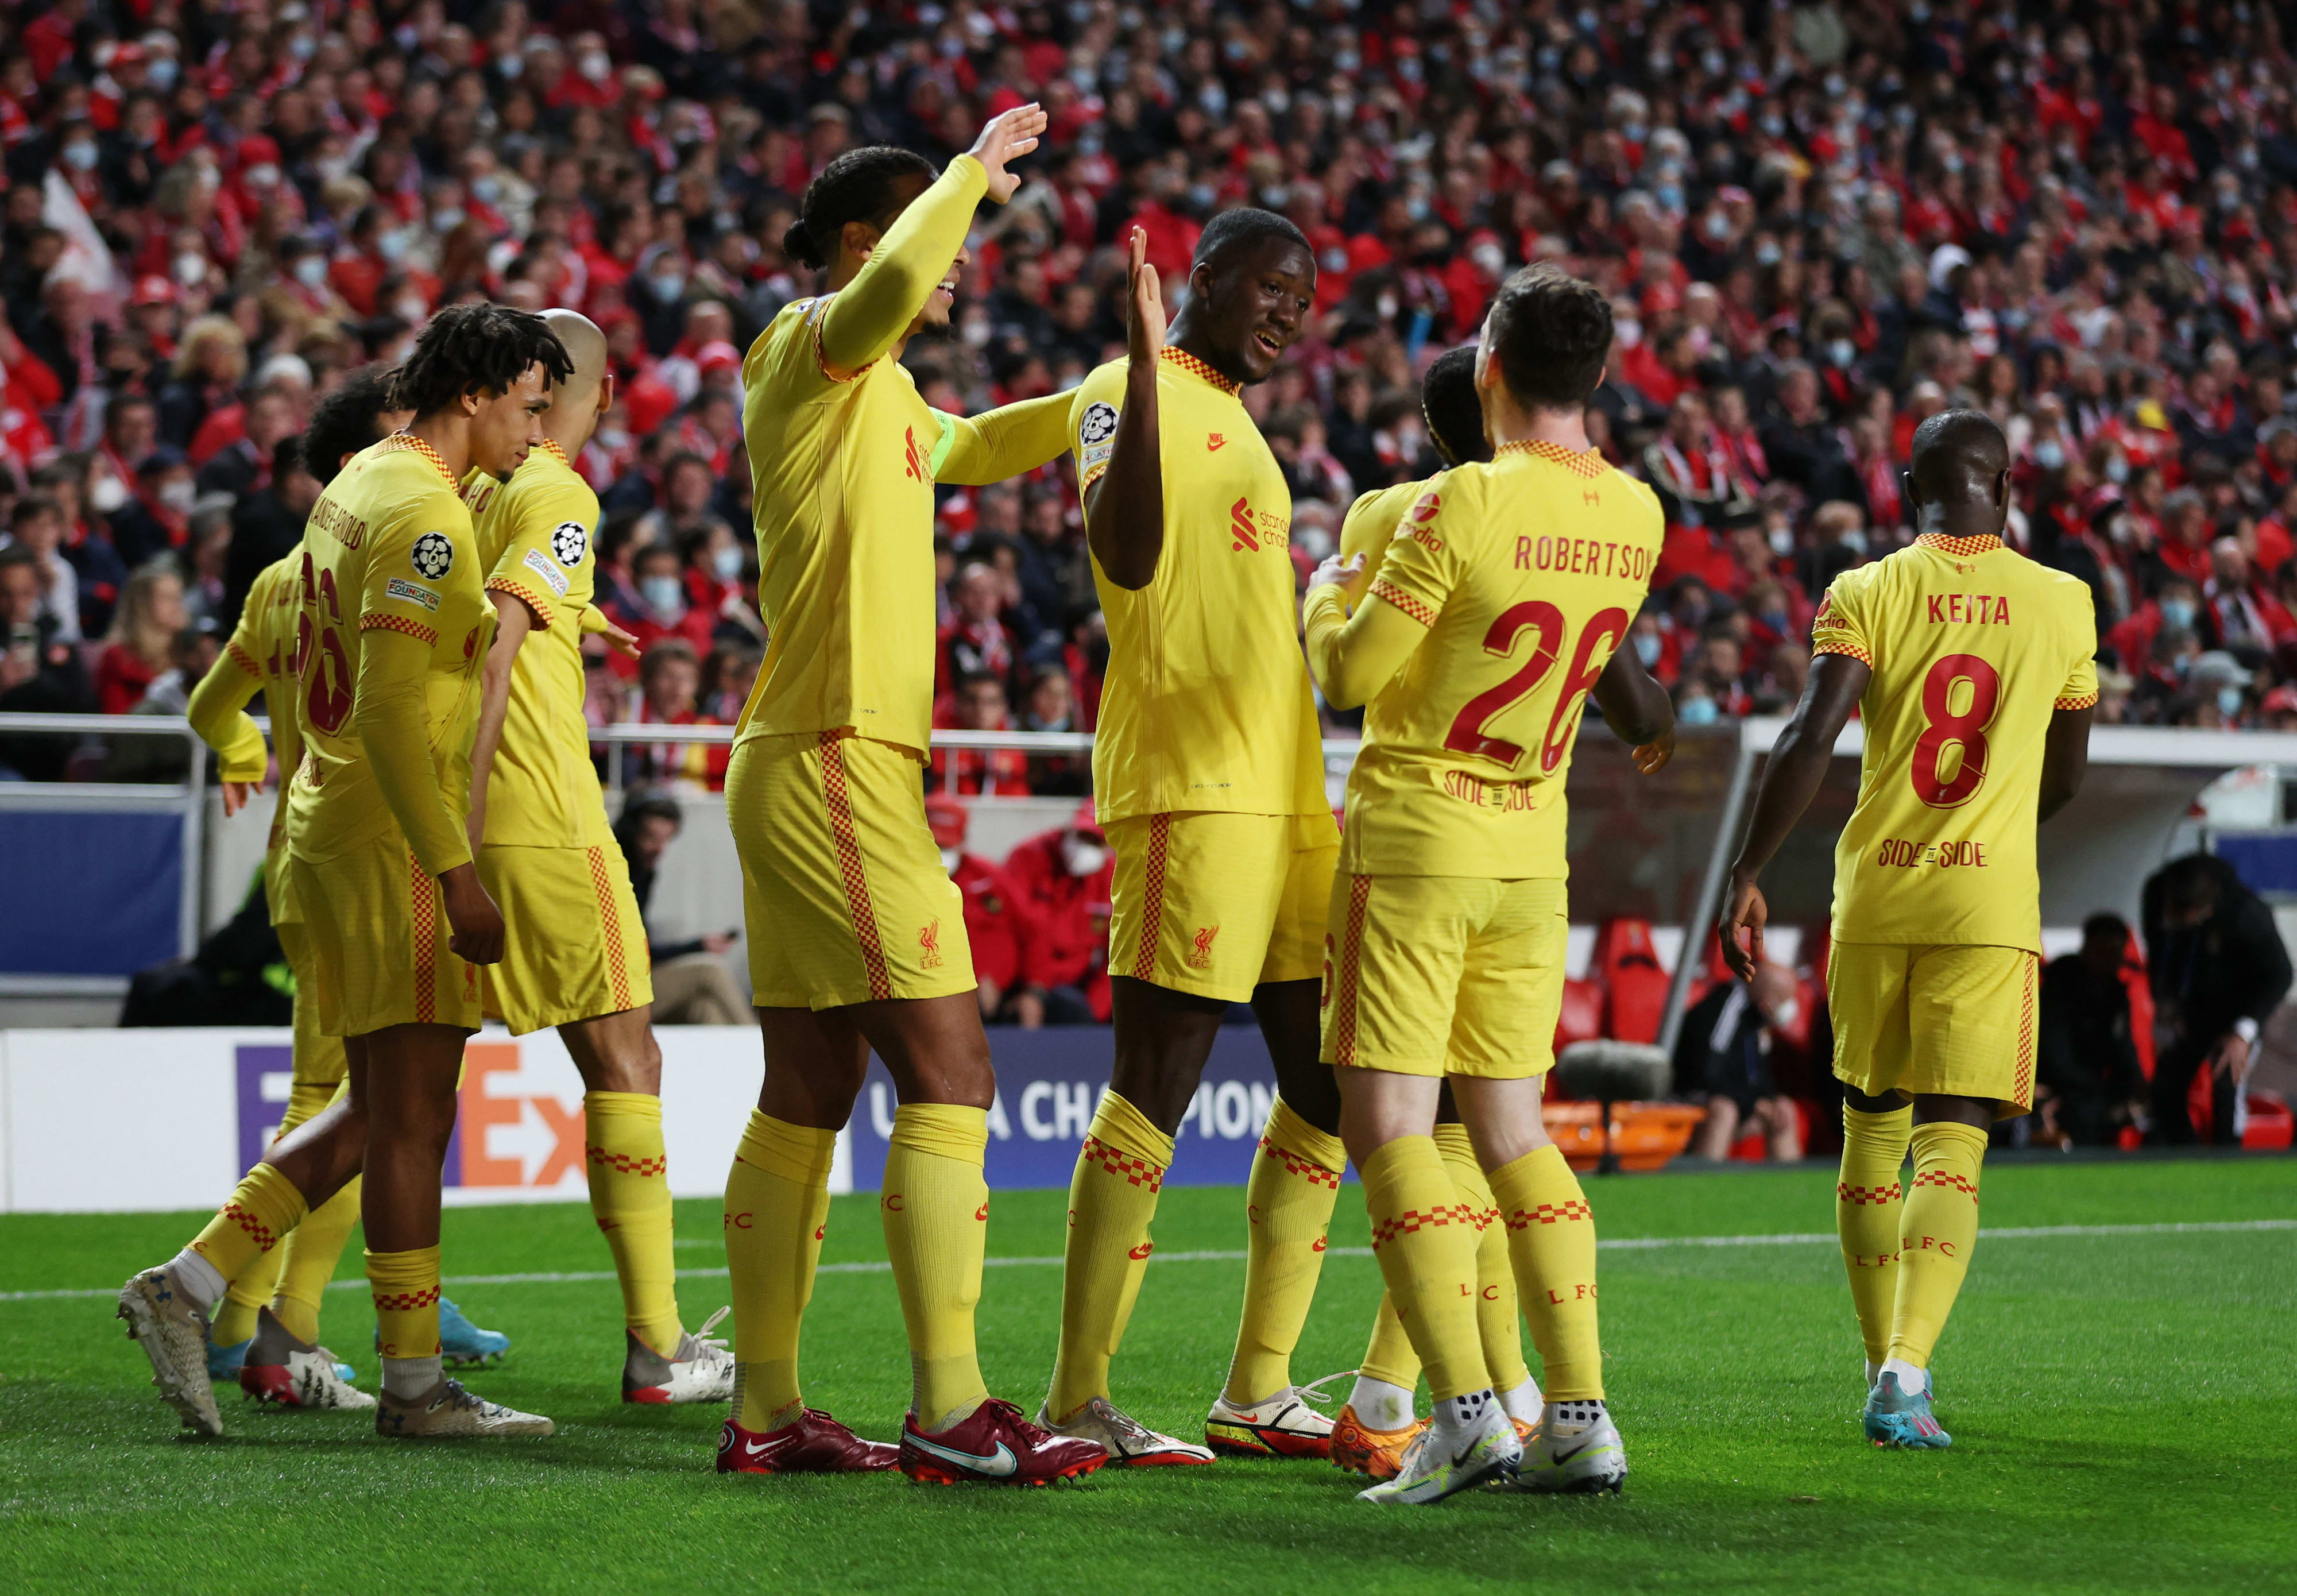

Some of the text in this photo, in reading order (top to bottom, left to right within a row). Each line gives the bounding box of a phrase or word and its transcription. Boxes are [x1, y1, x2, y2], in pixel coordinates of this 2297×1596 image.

[1209, 433, 1223, 443] NIKE
[389, 583, 439, 606] FOUNDATION
[1928, 594, 2010, 626] KEITA
[1444, 600, 1629, 777] 26
[1911, 654, 2002, 810] 8
[1878, 838, 1925, 868] SIDE
[1939, 841, 1988, 868] SIDE
